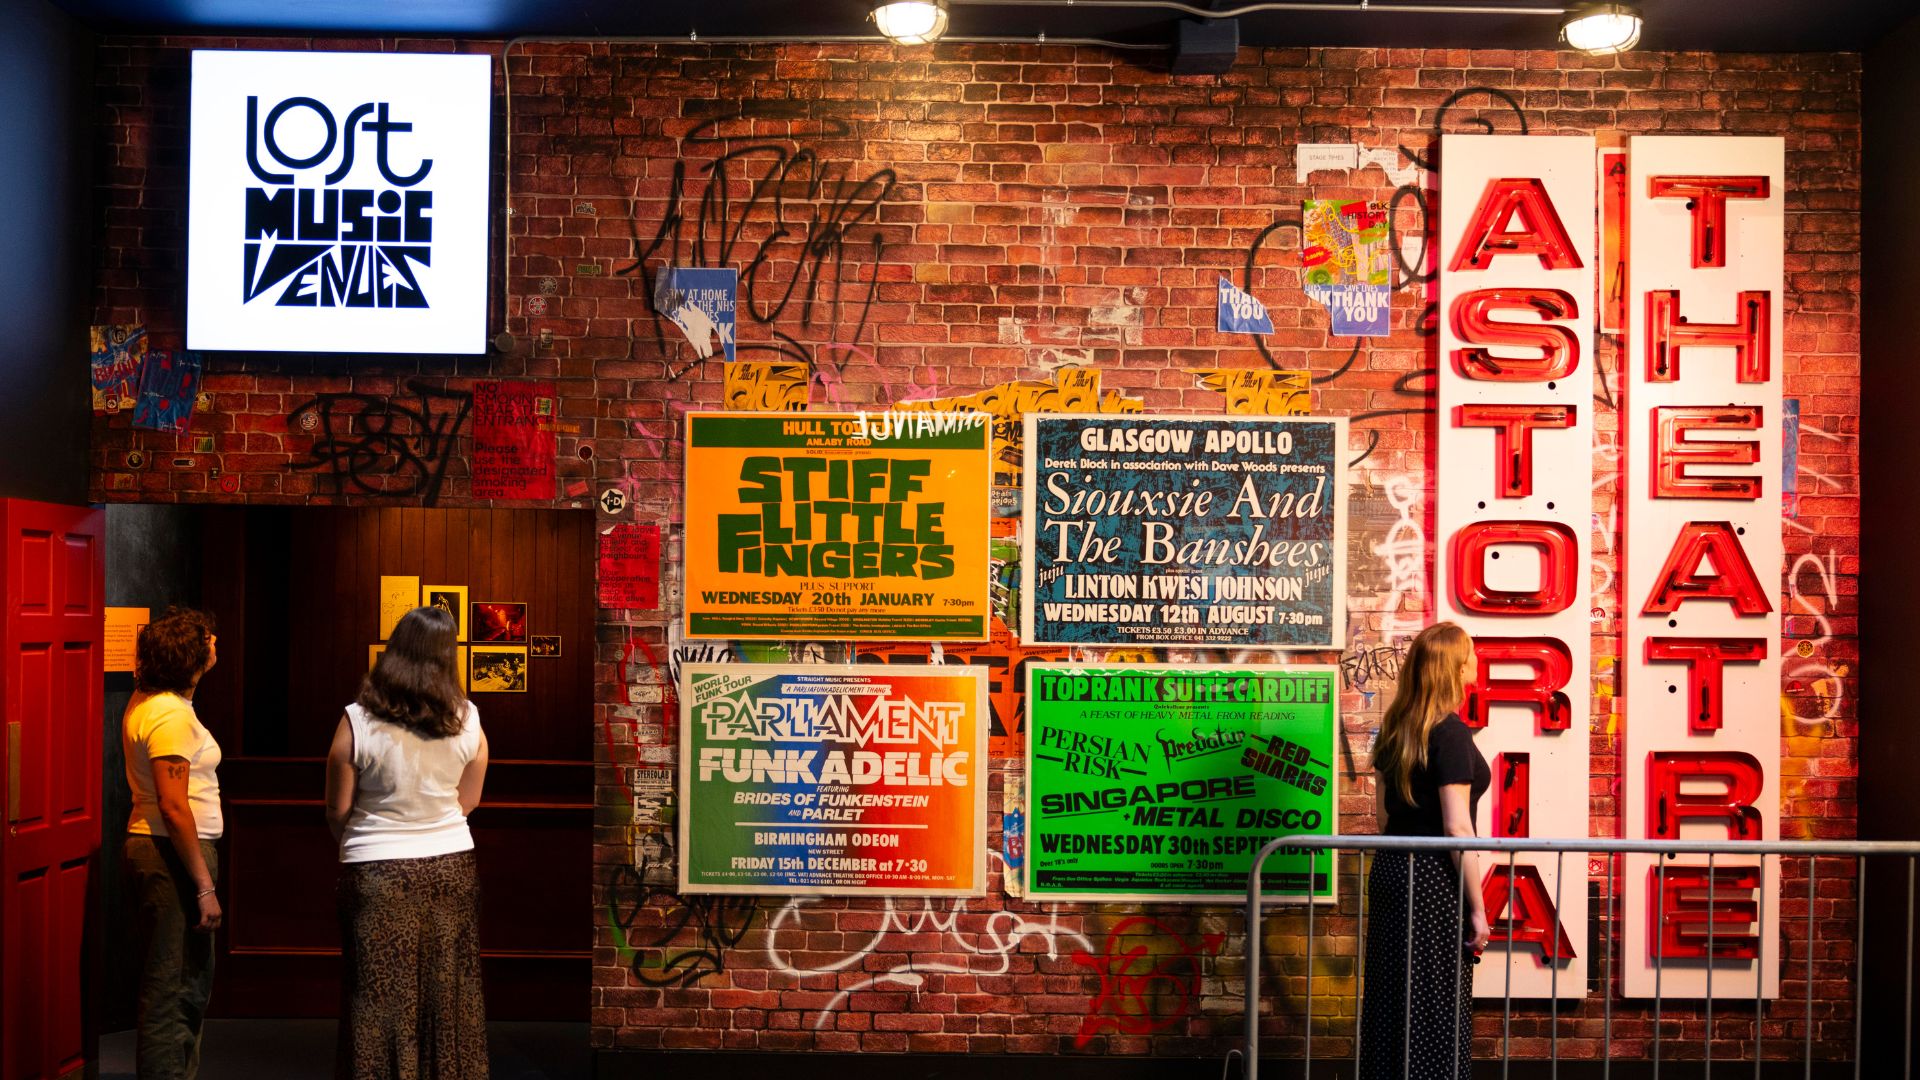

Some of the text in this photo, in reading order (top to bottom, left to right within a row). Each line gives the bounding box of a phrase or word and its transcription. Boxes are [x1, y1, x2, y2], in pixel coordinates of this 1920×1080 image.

[243, 243, 431, 308] VENUES
[688, 289, 698, 300] AT
[702, 289, 727, 301] HOME
[717, 301, 735, 312] NHS
[1332, 292, 1388, 308] THANK
[1231, 304, 1264, 319] YOU
[1345, 307, 1378, 322] YOU
[475, 383, 498, 393] NO
[783, 421, 828, 436] HULL
[806, 438, 844, 446] ANLABY
[1080, 427, 1292, 455] GLASGOW APOLLO
[1044, 458, 1326, 474] Derek Block in association with Dave Woods presents
[738, 456, 931, 503] STIFF
[1043, 472, 1326, 519] Siouxsie And
[762, 501, 945, 545] LITTLE
[718, 513, 955, 580] FINGERS
[1043, 519, 1324, 567] The Banshees
[1038, 564, 1064, 588] juju
[1305, 562, 1330, 588] juju
[1447, 178, 1584, 960] ASTORIA
[1639, 175, 1774, 960] THEATRE
[701, 591, 802, 605] WEDNESDAY
[811, 592, 852, 606] 20th
[859, 592, 935, 606] JANUARY
[800, 582, 876, 591] PLUS SUPPORT
[1065, 574, 1302, 603] LINTON KWESI JOHNSON
[1043, 603, 1154, 623] WEDNESDAY
[1160, 605, 1199, 624] 12th
[1207, 606, 1275, 624] AUGUST
[1117, 626, 1151, 634] TICKETS
[1208, 628, 1249, 636] ADVANCE
[693, 675, 730, 694] WORLD
[696, 675, 752, 703] FUNK TOUR
[1042, 677, 1329, 703] TOP RANK SUITE CARDIFF
[701, 690, 965, 751] PARLIAMENT
[1080, 710, 1295, 721] A FEAST OF HEAVY METAL FROM READING
[1039, 726, 1152, 764] PERSIAN
[1267, 735, 1311, 766] RED
[637, 770, 669, 779] STEREOLAB
[699, 747, 969, 787] FUNKADELIC
[1063, 753, 1122, 780] RISK
[1239, 747, 1327, 797] SHARKS
[733, 792, 929, 807] BRIDES OF FUNKENSTEIN
[1041, 775, 1256, 815] SINGAPORE
[802, 808, 864, 821] PARLET
[1133, 806, 1225, 828] METAL
[1236, 809, 1322, 830] DISCO
[755, 832, 899, 847] BIRMINGHAM ODEON
[1040, 834, 1165, 855] WEDNESDAY
[1169, 835, 1210, 856] 30th
[731, 856, 776, 870] FRIDAY
[778, 857, 804, 871] 15th
[807, 858, 877, 872] DECEMBER
[879, 860, 892, 872] at
